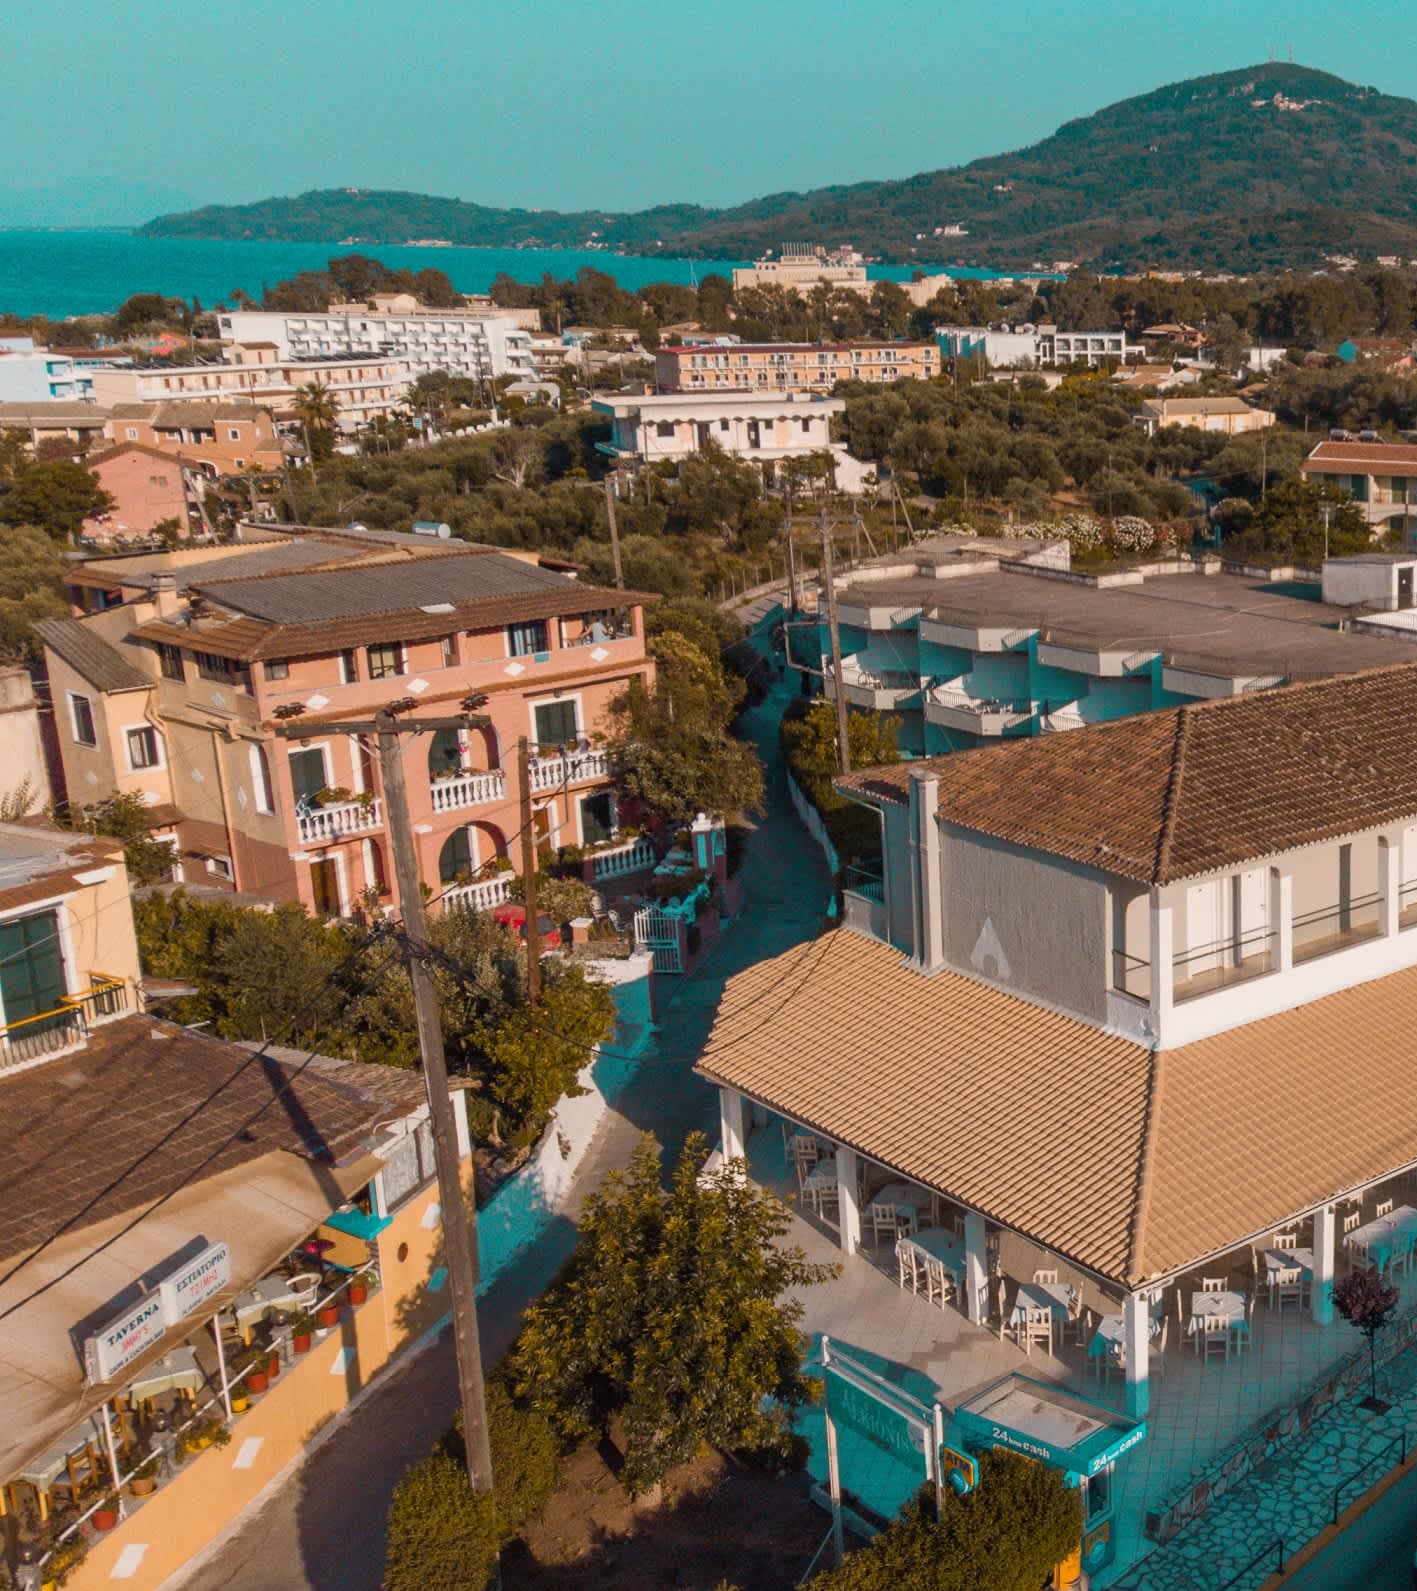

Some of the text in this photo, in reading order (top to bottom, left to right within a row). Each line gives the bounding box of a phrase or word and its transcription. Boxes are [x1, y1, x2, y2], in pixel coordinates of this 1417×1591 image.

[107, 1303, 159, 1346] TAVERNA
[992, 1427, 1050, 1460] 24 cash
[1093, 1453, 1106, 1471] 24
[1119, 1431, 1142, 1452] cash
